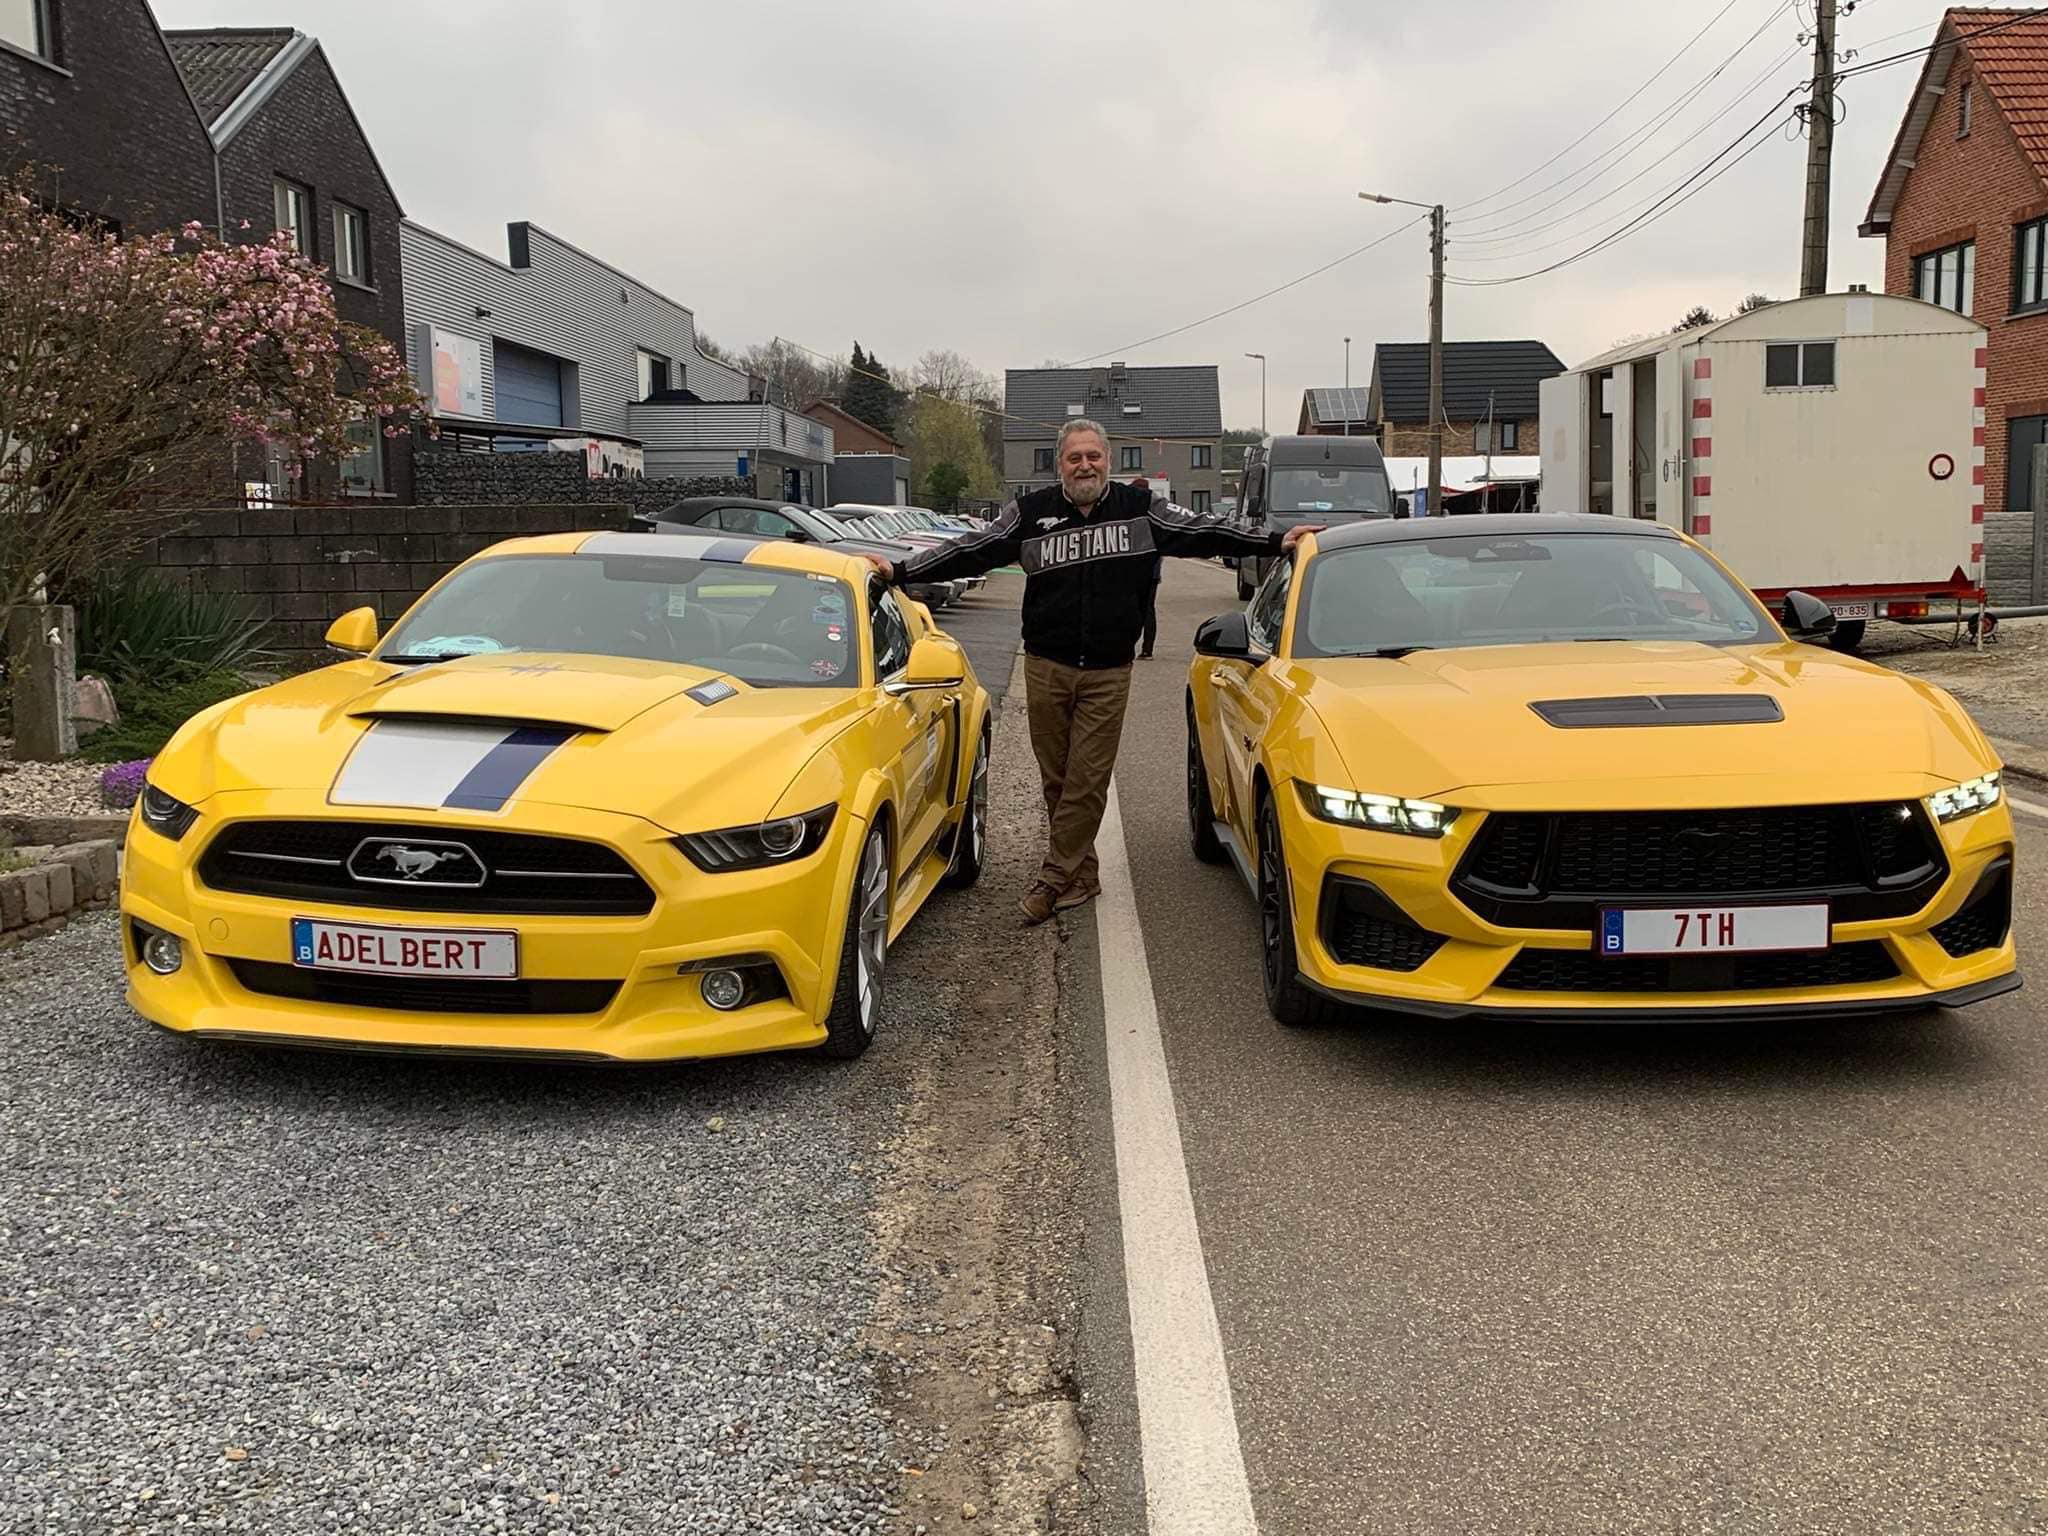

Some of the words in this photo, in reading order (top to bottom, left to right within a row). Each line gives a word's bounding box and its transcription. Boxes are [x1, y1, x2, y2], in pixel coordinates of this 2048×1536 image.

[1040, 525, 1129, 568] MUSTANG
[300, 946, 312, 960] B
[317, 931, 487, 970] ADELBERT
[1607, 935, 1620, 949] B
[1674, 913, 1734, 947] 7TH
